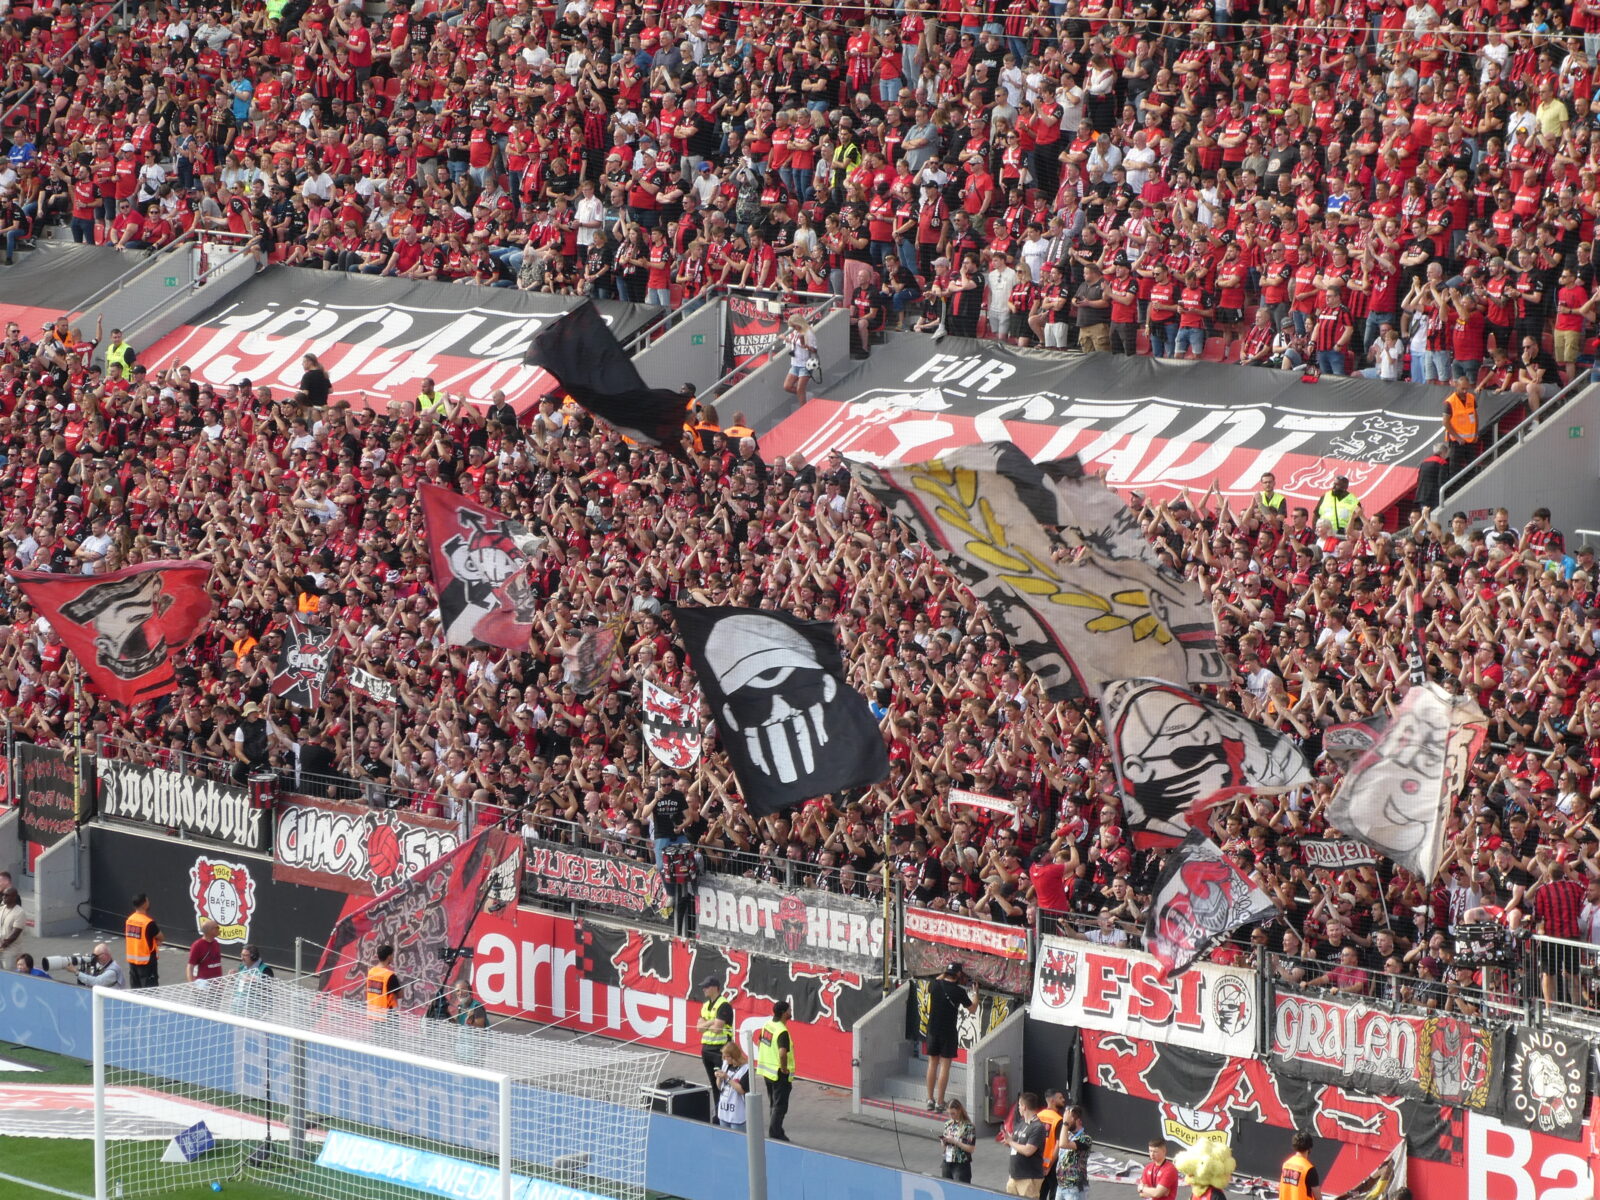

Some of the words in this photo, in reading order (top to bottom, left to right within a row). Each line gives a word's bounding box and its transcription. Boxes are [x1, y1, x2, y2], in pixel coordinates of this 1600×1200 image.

[904, 352, 1016, 394] FÜR
[976, 394, 1356, 492] STADT
[278, 806, 365, 880] CHAOS
[526, 846, 650, 896] JUGEND
[537, 878, 645, 912] LEVERKUSEN
[210, 896, 235, 907] BAYER
[1510, 1032, 1567, 1123] COMMANDO
[1565, 1058, 1581, 1109] 1989
[325, 1131, 417, 1182] NIEDAX
